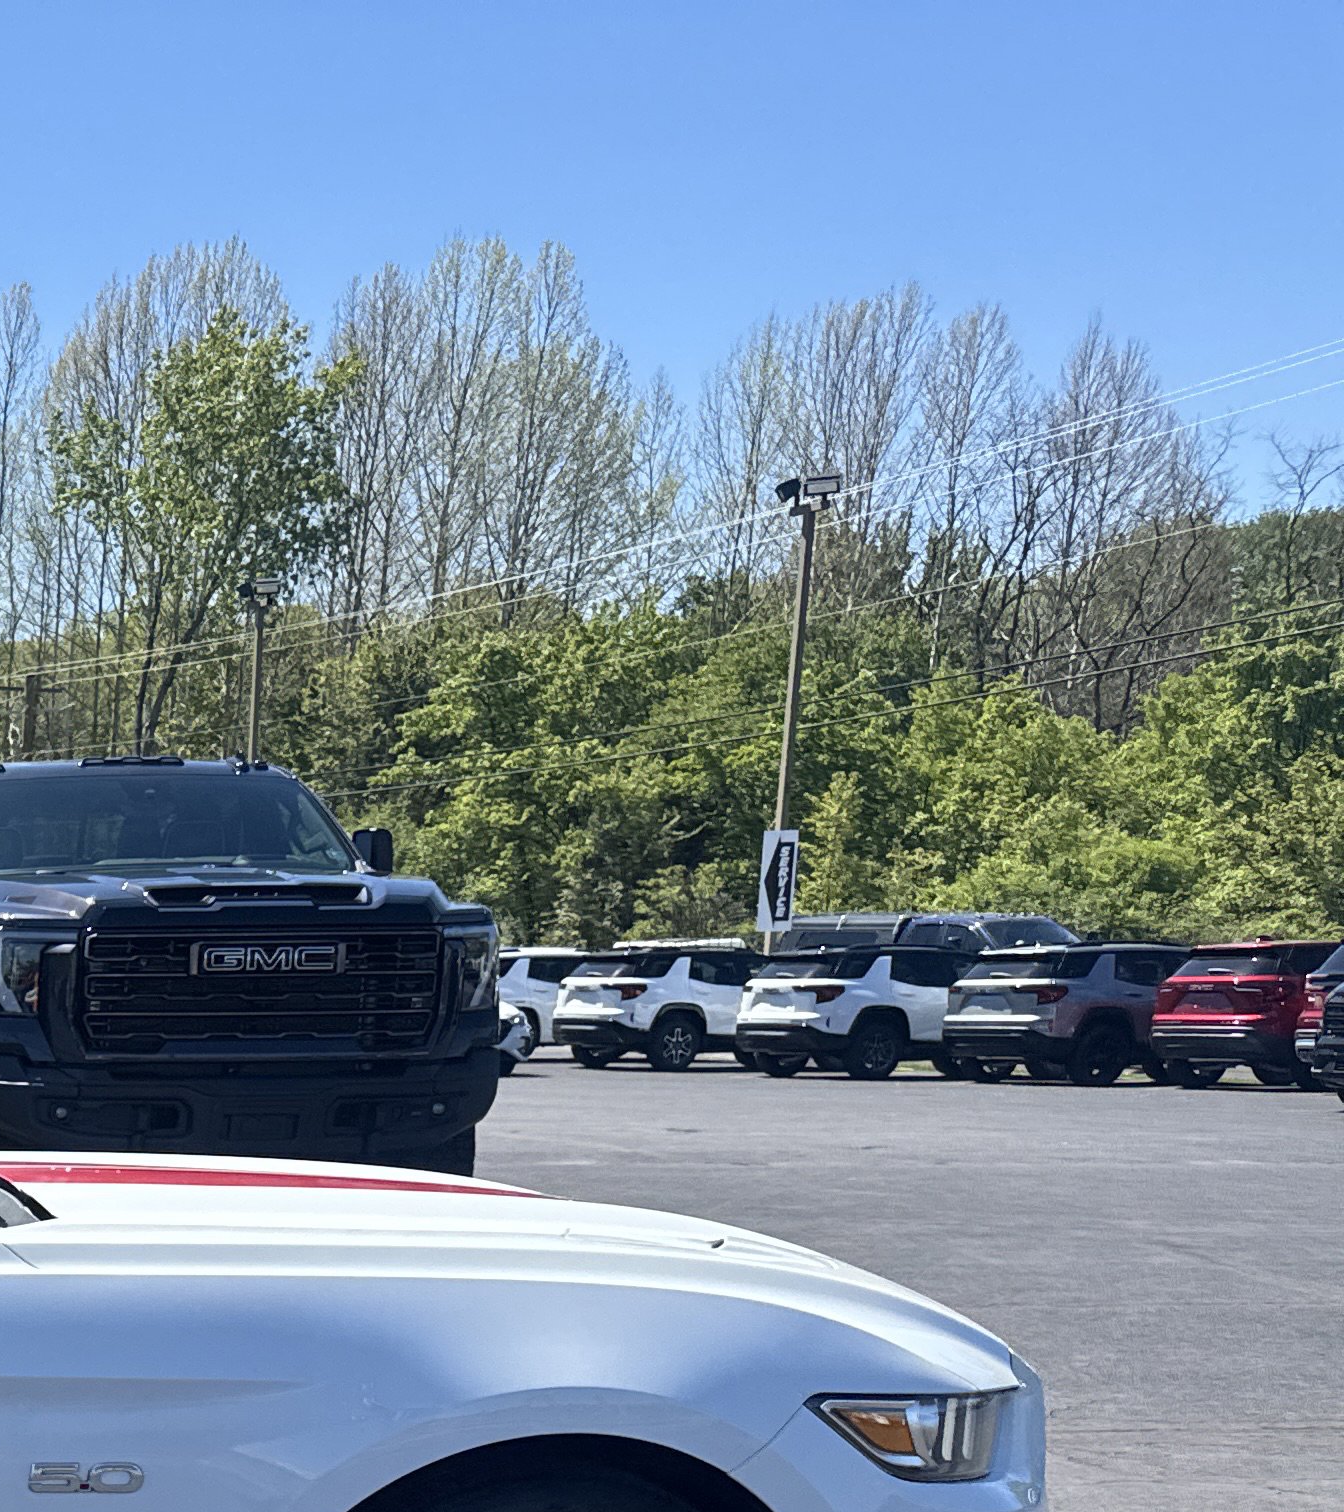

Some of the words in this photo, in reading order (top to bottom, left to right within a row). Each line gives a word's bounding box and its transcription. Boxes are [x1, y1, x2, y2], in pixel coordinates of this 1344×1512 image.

[775, 845, 792, 918] SERVICE
[203, 946, 336, 972] GMC
[28, 1462, 145, 1494] 5.0
